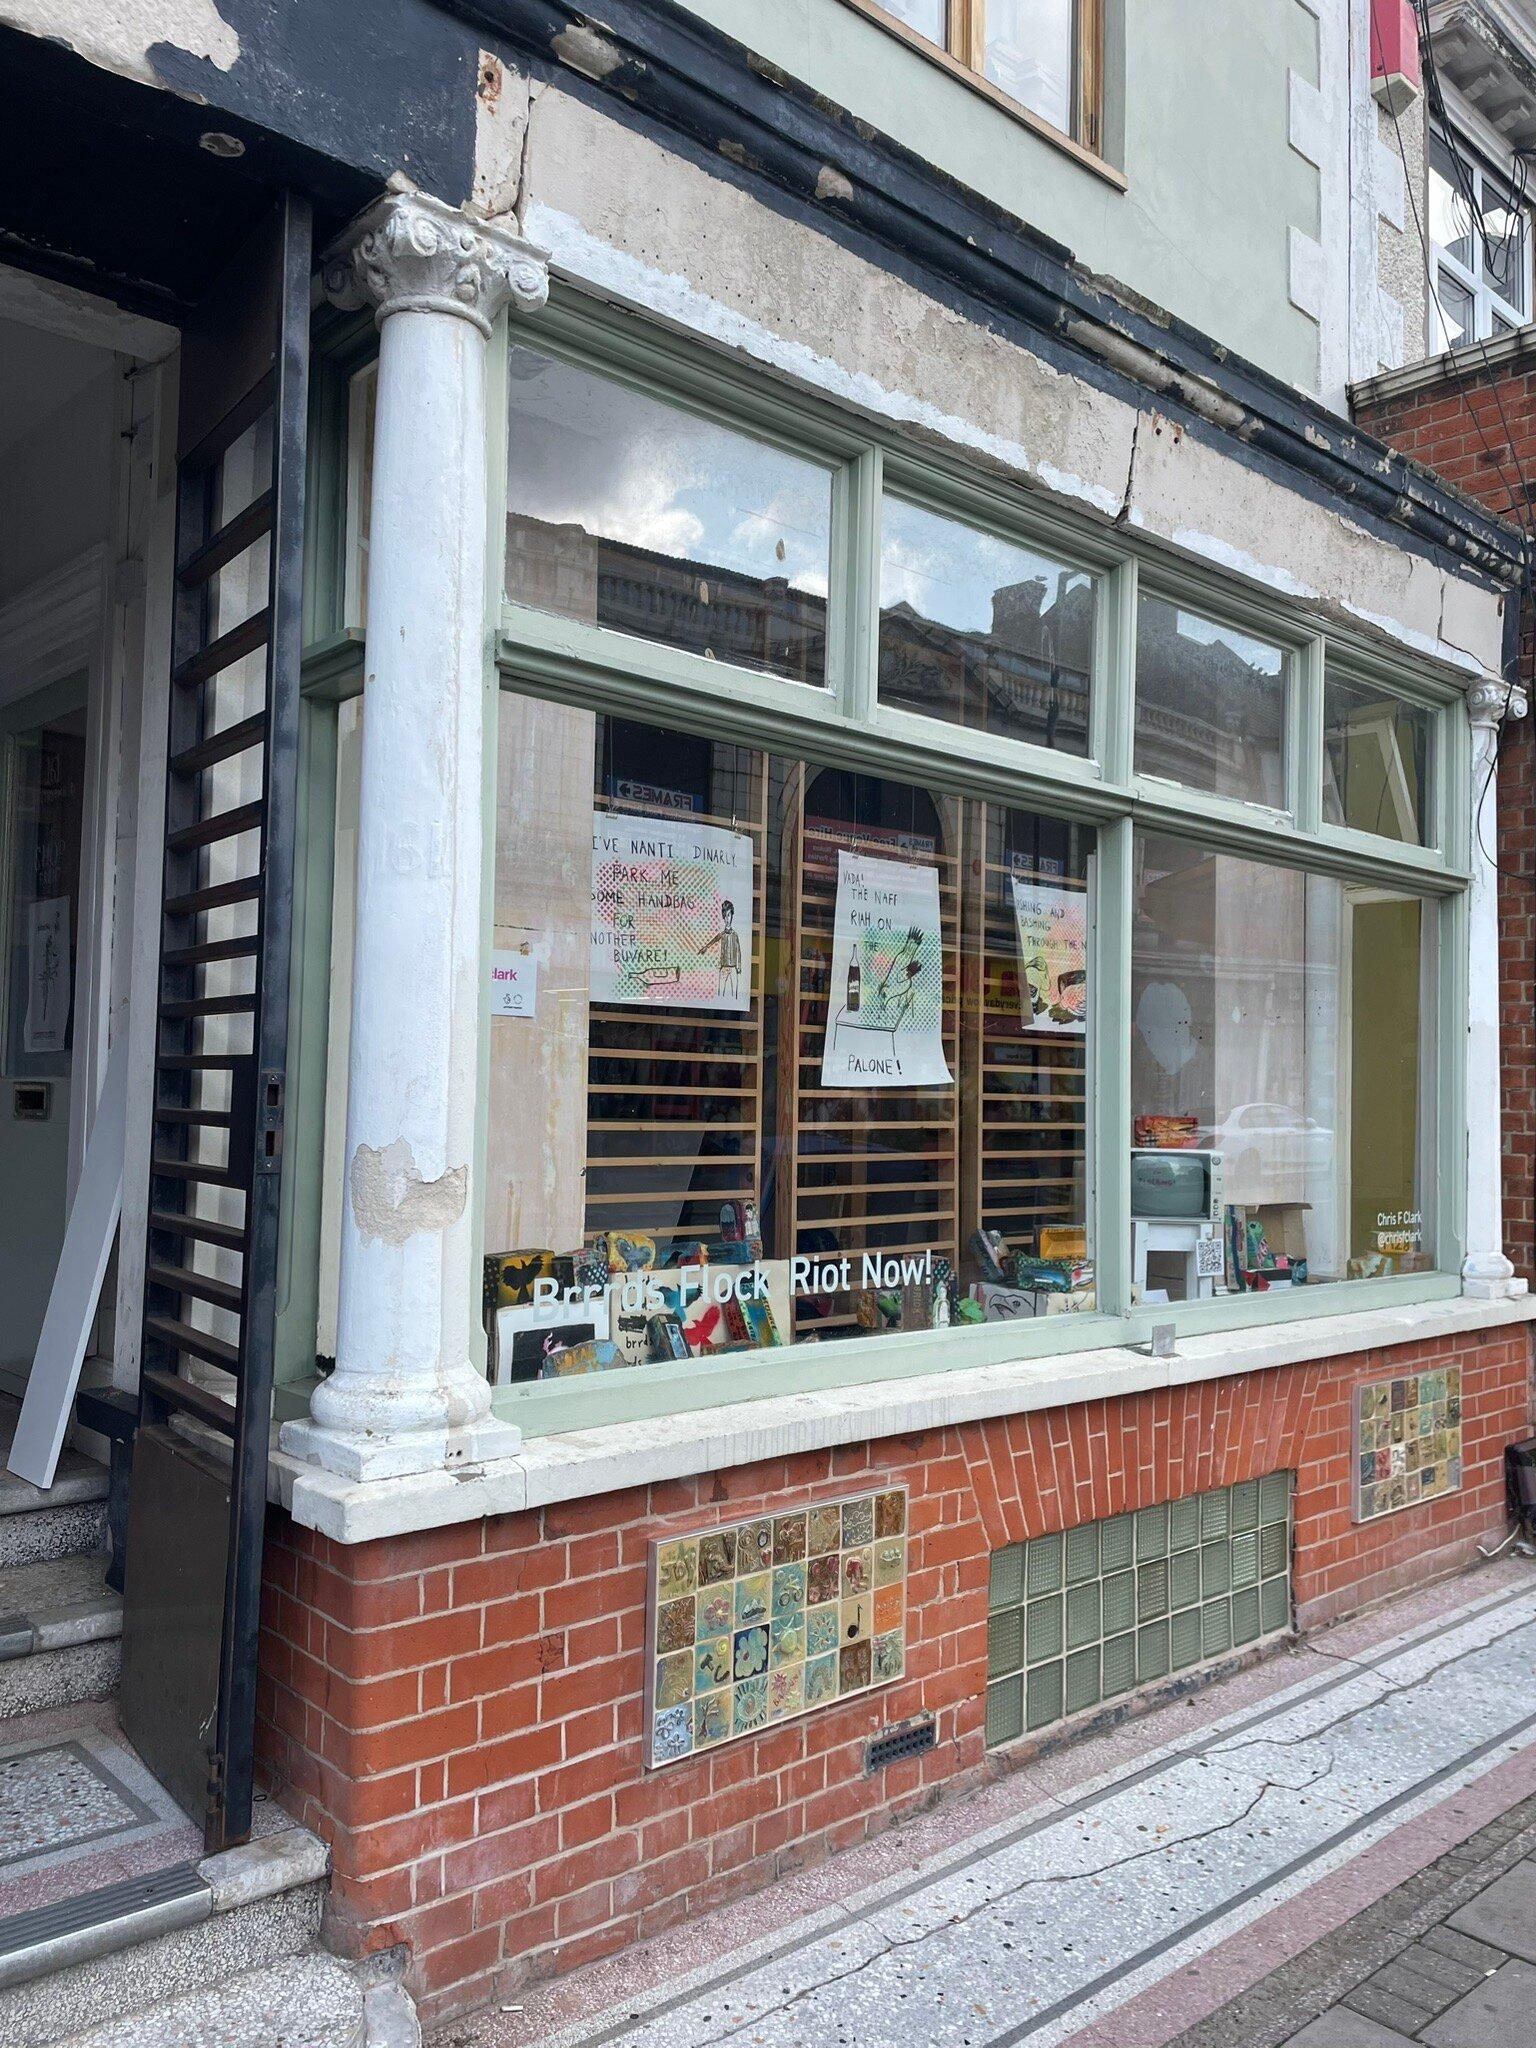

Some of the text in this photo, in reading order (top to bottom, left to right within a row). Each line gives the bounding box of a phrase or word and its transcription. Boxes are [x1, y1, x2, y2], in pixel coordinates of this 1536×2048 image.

[592, 836, 618, 852] I'VE
[631, 840, 673, 858] NANTI
[612, 864, 679, 887] PARK ME
[638, 891, 695, 909] HANDBAG
[852, 888, 898, 906] THE NAFF
[613, 913, 635, 929] FOR
[850, 909, 892, 930] RIAH ON
[1050, 907, 1065, 919] AND
[864, 940, 879, 952] THE
[848, 1054, 902, 1075] PALONE!
[1377, 1210, 1423, 1226] Chris F Clark
[680, 1259, 771, 1307] Flock
[789, 1255, 851, 1296] Riot
[862, 1248, 932, 1290] Now!
